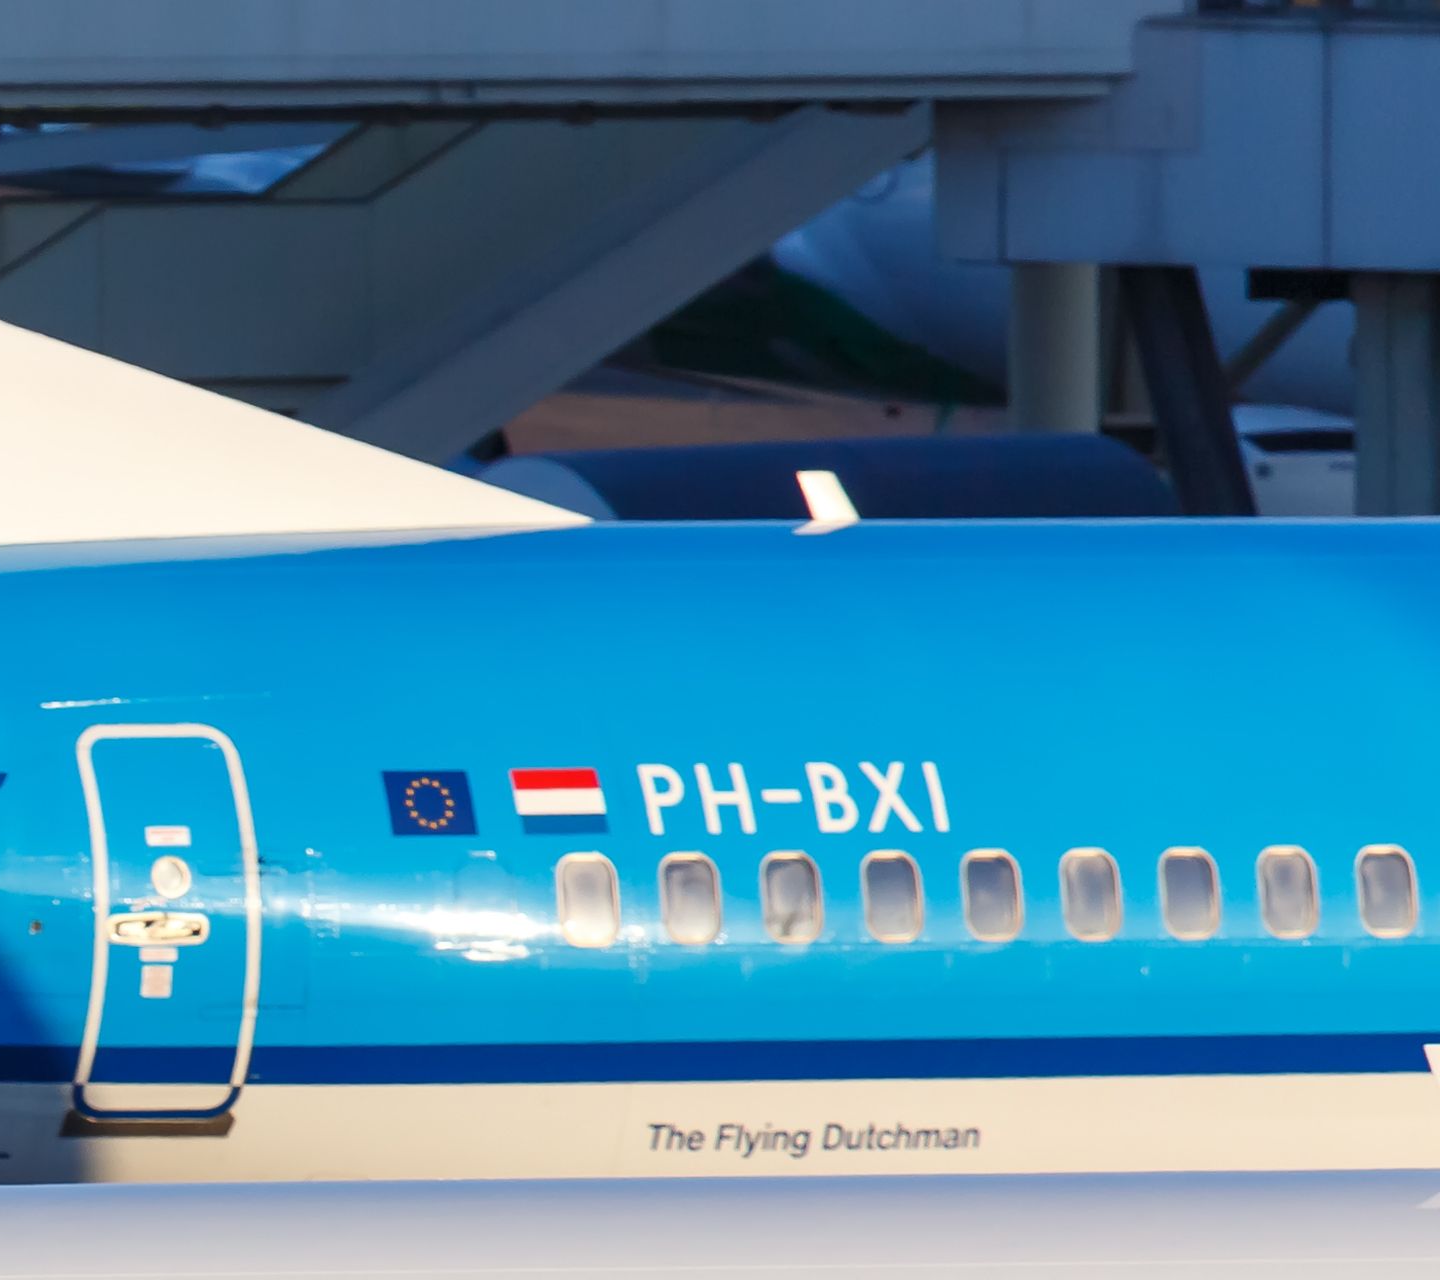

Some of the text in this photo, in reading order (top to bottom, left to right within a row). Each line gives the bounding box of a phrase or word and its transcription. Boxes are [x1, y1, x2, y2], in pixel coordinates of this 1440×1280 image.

[637, 761, 950, 836] PH-BXI
[648, 1122, 980, 1158] The Flying Dutchman
